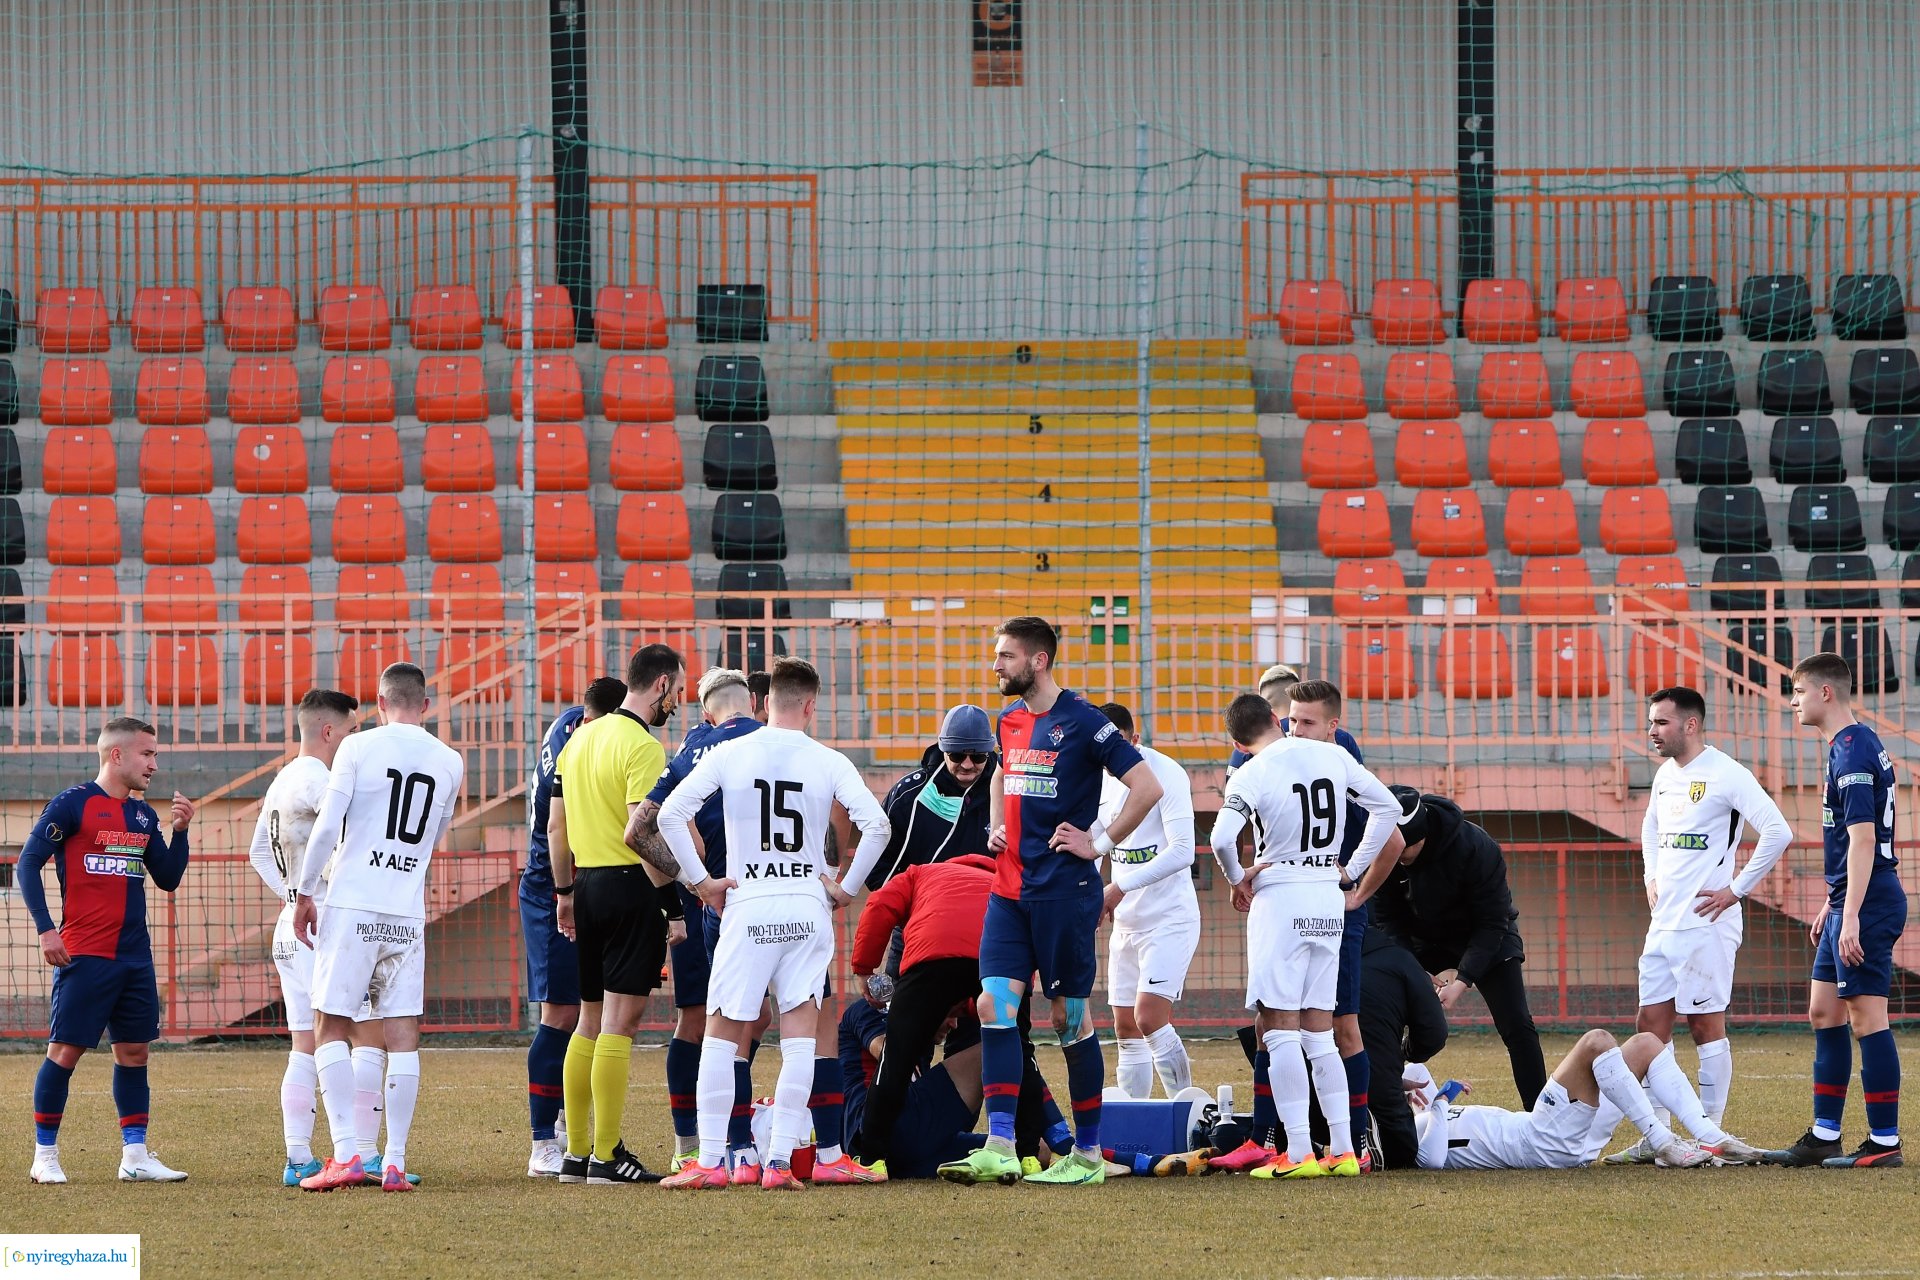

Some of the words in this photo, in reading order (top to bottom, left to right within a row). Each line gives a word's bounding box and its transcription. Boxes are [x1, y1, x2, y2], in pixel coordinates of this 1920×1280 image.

[1029, 414, 1043, 434] 5
[1038, 484, 1051, 503] 4
[1036, 553, 1050, 572] 3
[386, 768, 435, 844] 10
[754, 779, 803, 852] 15
[1293, 778, 1336, 852] 19
[386, 854, 418, 873] ALEF
[764, 863, 813, 878] ALEF
[747, 921, 815, 938] PRO-TERMINAL
[1293, 918, 1343, 930] PRO-TERMINA
